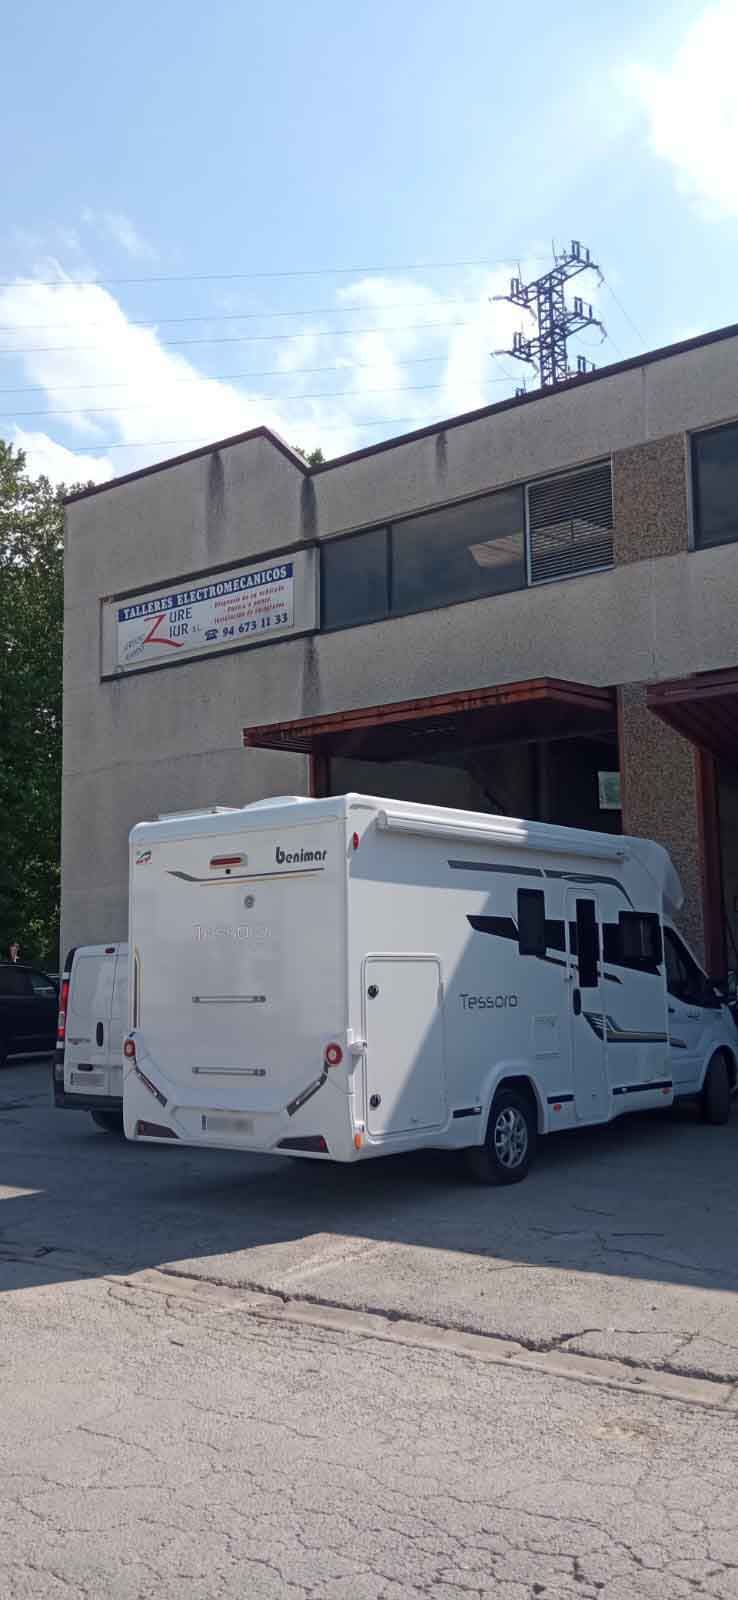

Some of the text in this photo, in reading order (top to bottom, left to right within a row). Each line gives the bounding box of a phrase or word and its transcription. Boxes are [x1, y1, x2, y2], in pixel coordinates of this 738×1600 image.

[123, 566, 287, 619] TALLERES ELECTROMECANICOS
[222, 612, 289, 638] 94 673 11 33
[275, 846, 327, 864] benimar
[459, 992, 519, 1010] Tessoro
